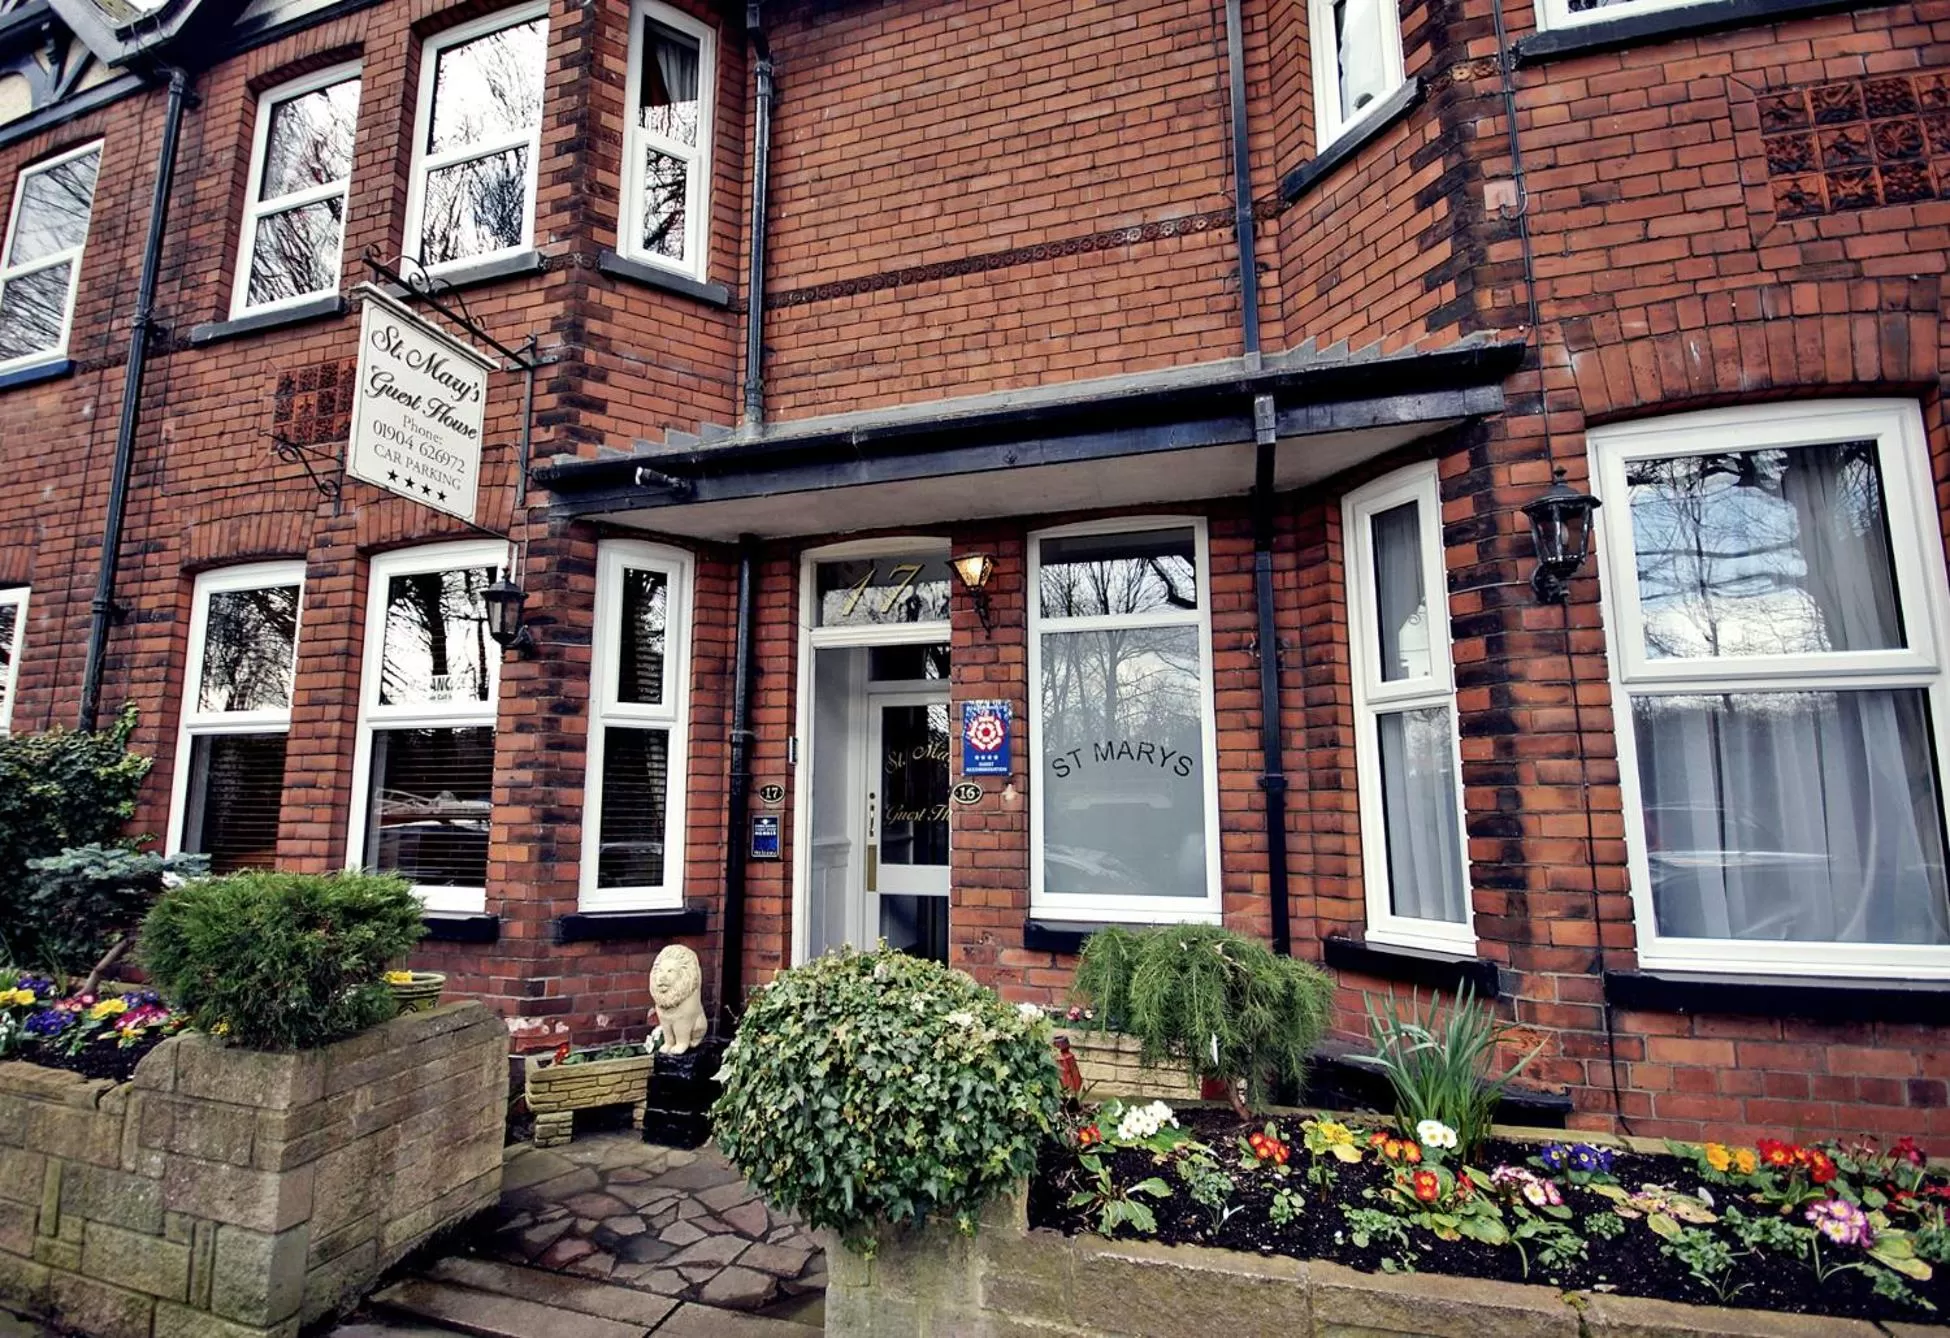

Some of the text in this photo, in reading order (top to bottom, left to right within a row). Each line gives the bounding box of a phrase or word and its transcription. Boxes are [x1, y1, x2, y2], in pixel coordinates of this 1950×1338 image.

[371, 325, 480, 403] St. Mary's
[365, 365, 478, 440] Guest House
[373, 420, 466, 474] 01904 626972
[402, 415, 444, 445] Phone:
[374, 444, 462, 491] CAR PARKING
[842, 563, 925, 617] 17
[1052, 740, 1194, 778] ST MARYS
[765, 787, 779, 800] 17
[959, 786, 976, 800] 16
